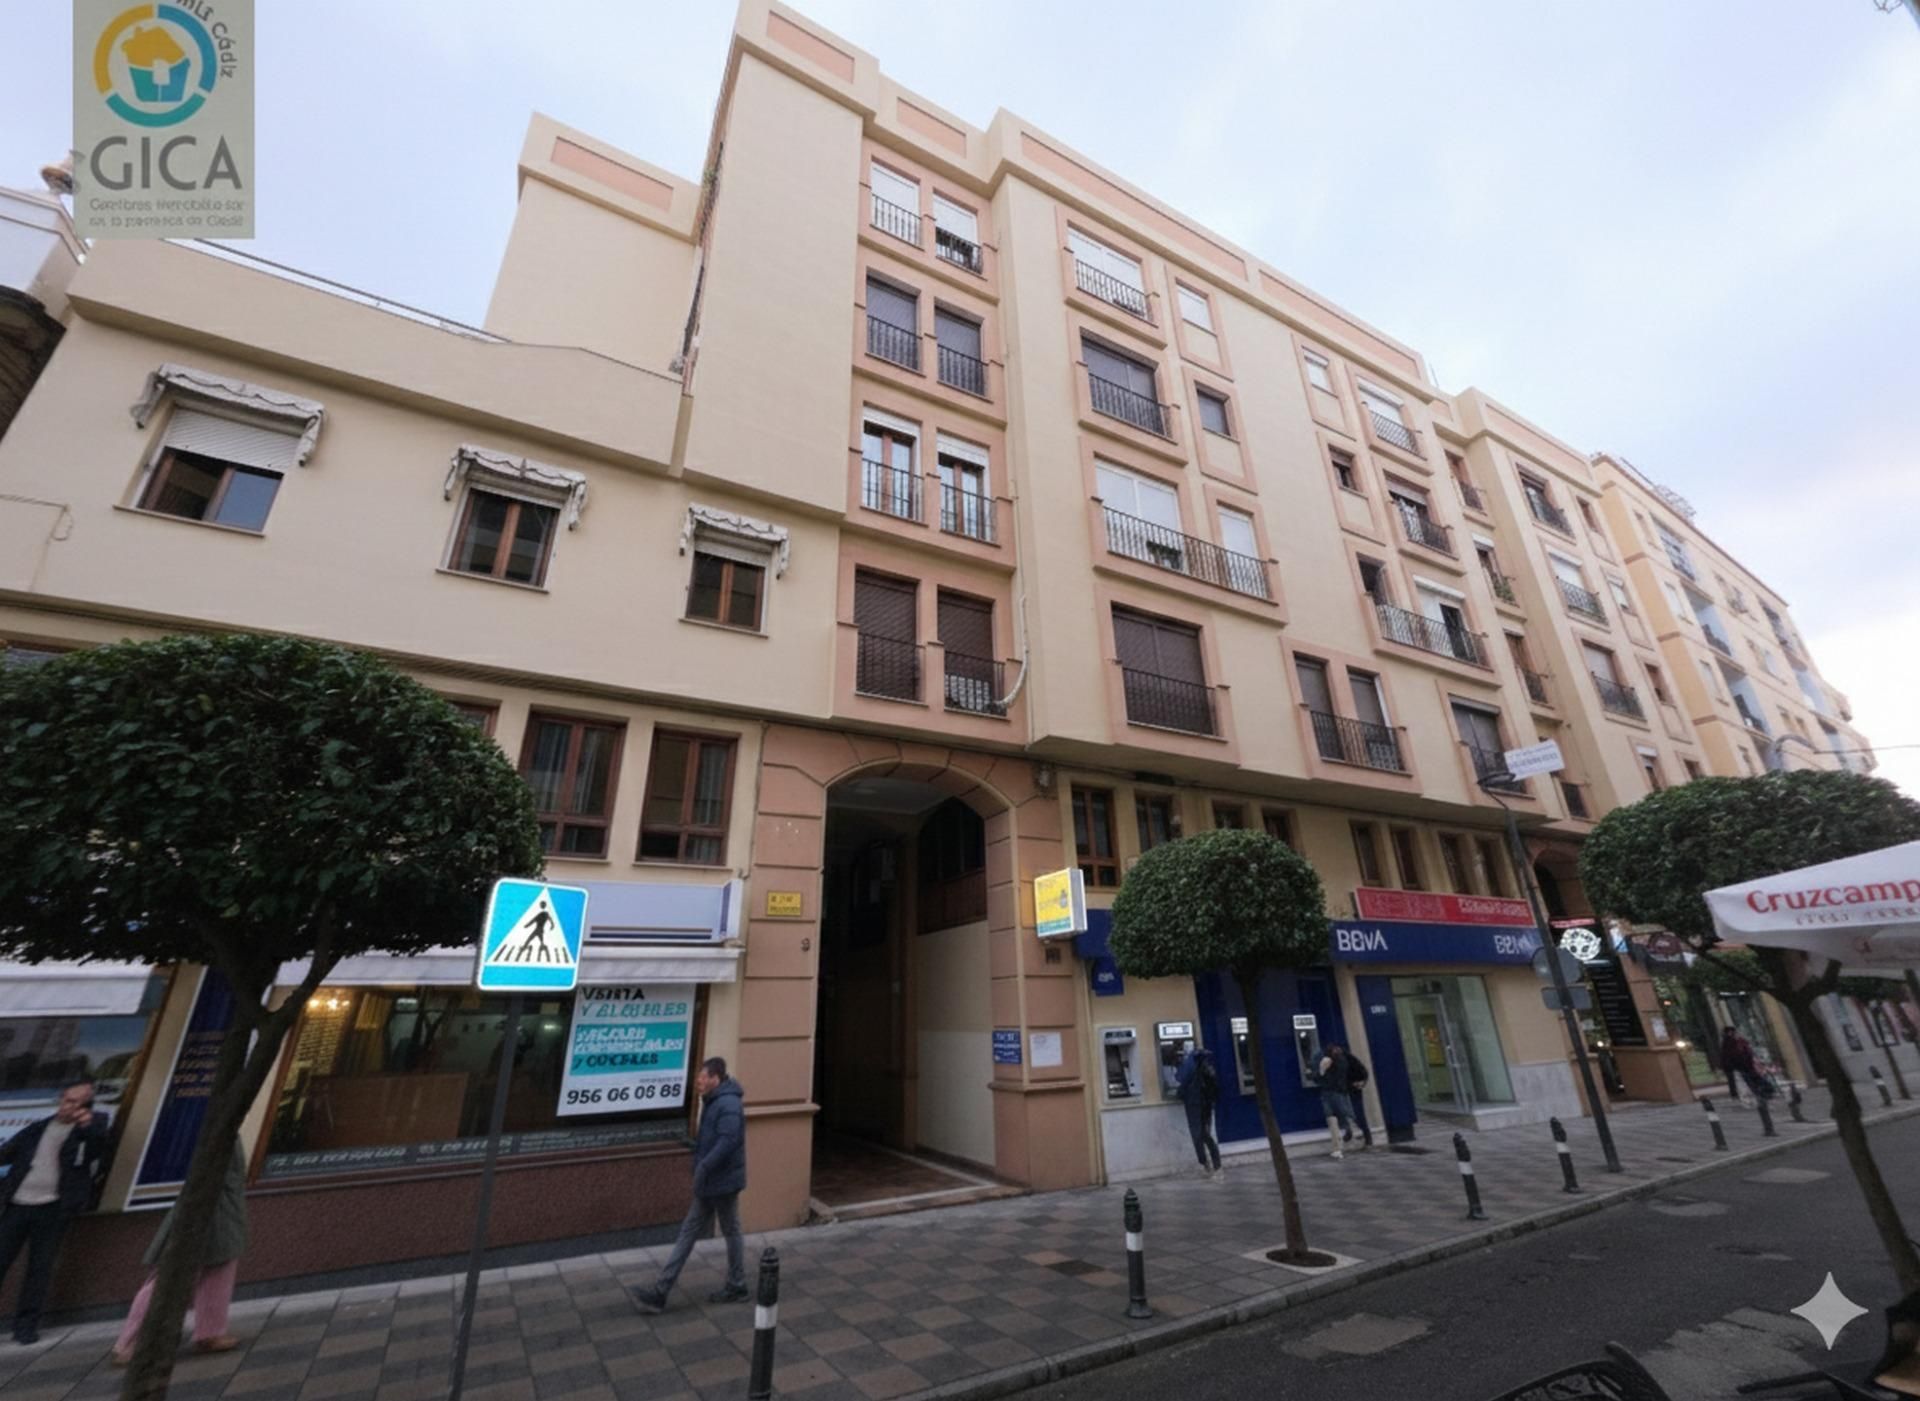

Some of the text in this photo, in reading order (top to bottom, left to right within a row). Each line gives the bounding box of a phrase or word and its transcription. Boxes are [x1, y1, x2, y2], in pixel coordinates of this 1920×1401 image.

[1746, 880, 1920, 914] Cruzcamp
[1336, 929, 1388, 951] BBVA
[566, 1089, 602, 1105] 956
[607, 1087, 630, 1102] 06
